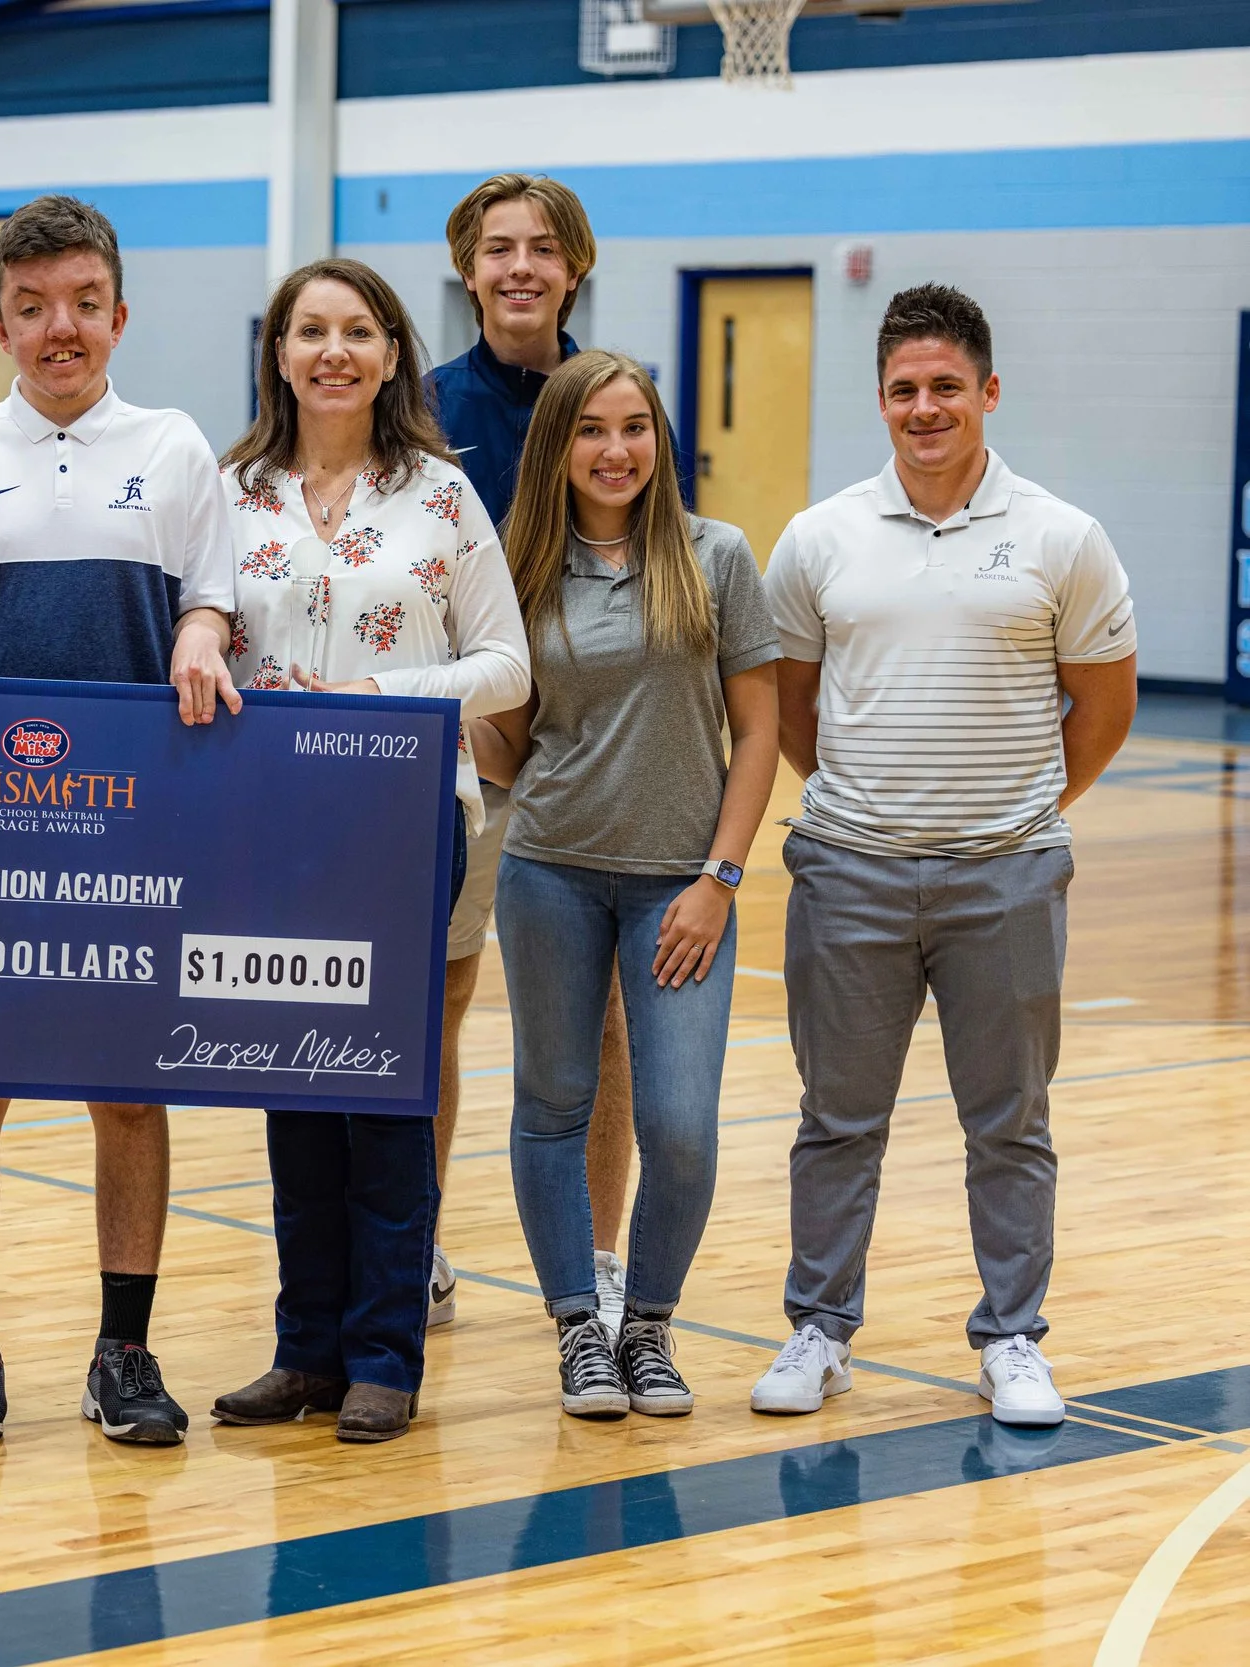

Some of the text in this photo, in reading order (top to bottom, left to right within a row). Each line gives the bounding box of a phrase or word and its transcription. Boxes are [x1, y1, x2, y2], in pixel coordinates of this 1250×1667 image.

[974, 573, 1019, 582] BASKETBALL
[11, 727, 62, 747] Jersey
[295, 731, 419, 759] MARCH 2022
[41, 810, 106, 821] BASKETBALL
[45, 820, 106, 835] AWARD
[54, 872, 184, 906] ACADEMY
[187, 947, 366, 989] $1,000.00
[157, 1023, 402, 1082] Jersey Mike's
